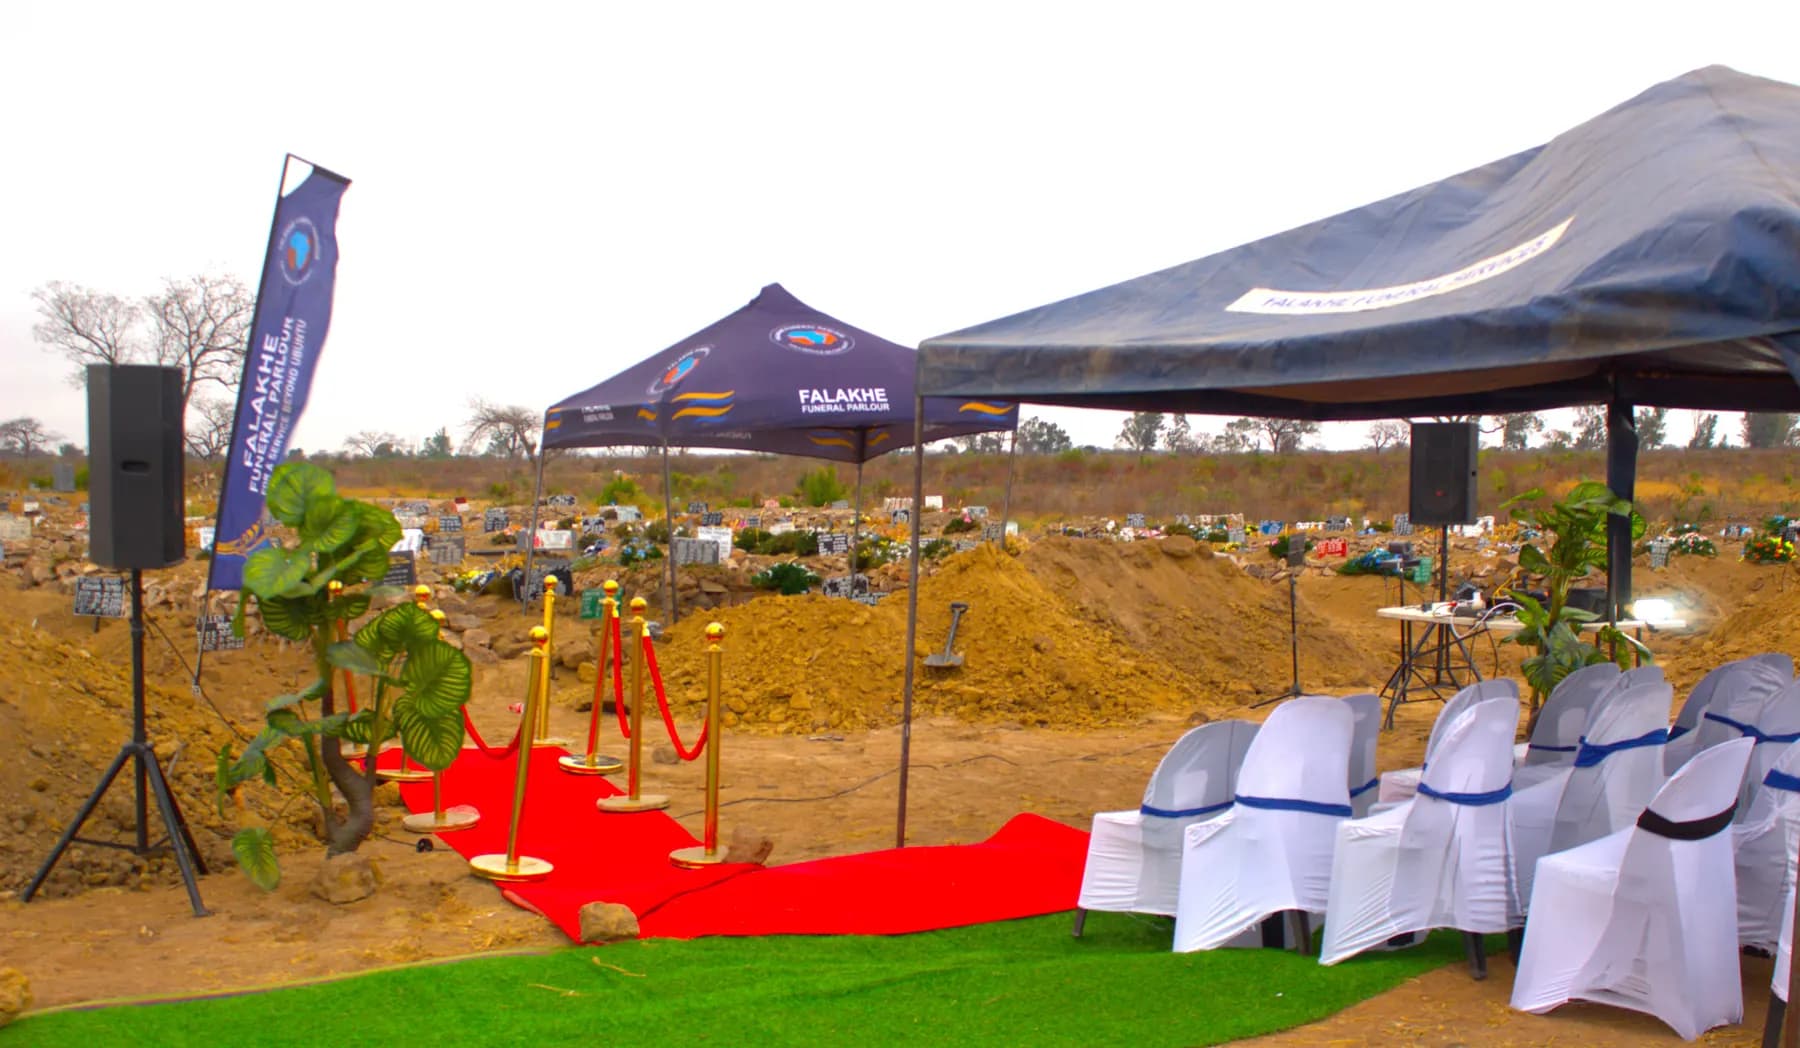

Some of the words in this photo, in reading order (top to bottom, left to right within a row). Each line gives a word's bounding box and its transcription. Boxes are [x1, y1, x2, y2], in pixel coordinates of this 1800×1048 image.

[243, 333, 280, 468] FALAKHE
[249, 408, 279, 493] FUNERAL
[268, 316, 295, 404] PARLOUR
[268, 413, 290, 462] SERVICE
[281, 367, 299, 414] BEYOND
[290, 319, 307, 367] UBUNTU
[798, 388, 888, 404] FALAKHE
[801, 403, 846, 413] FUNERAL
[846, 402, 890, 412] PARLOUR
